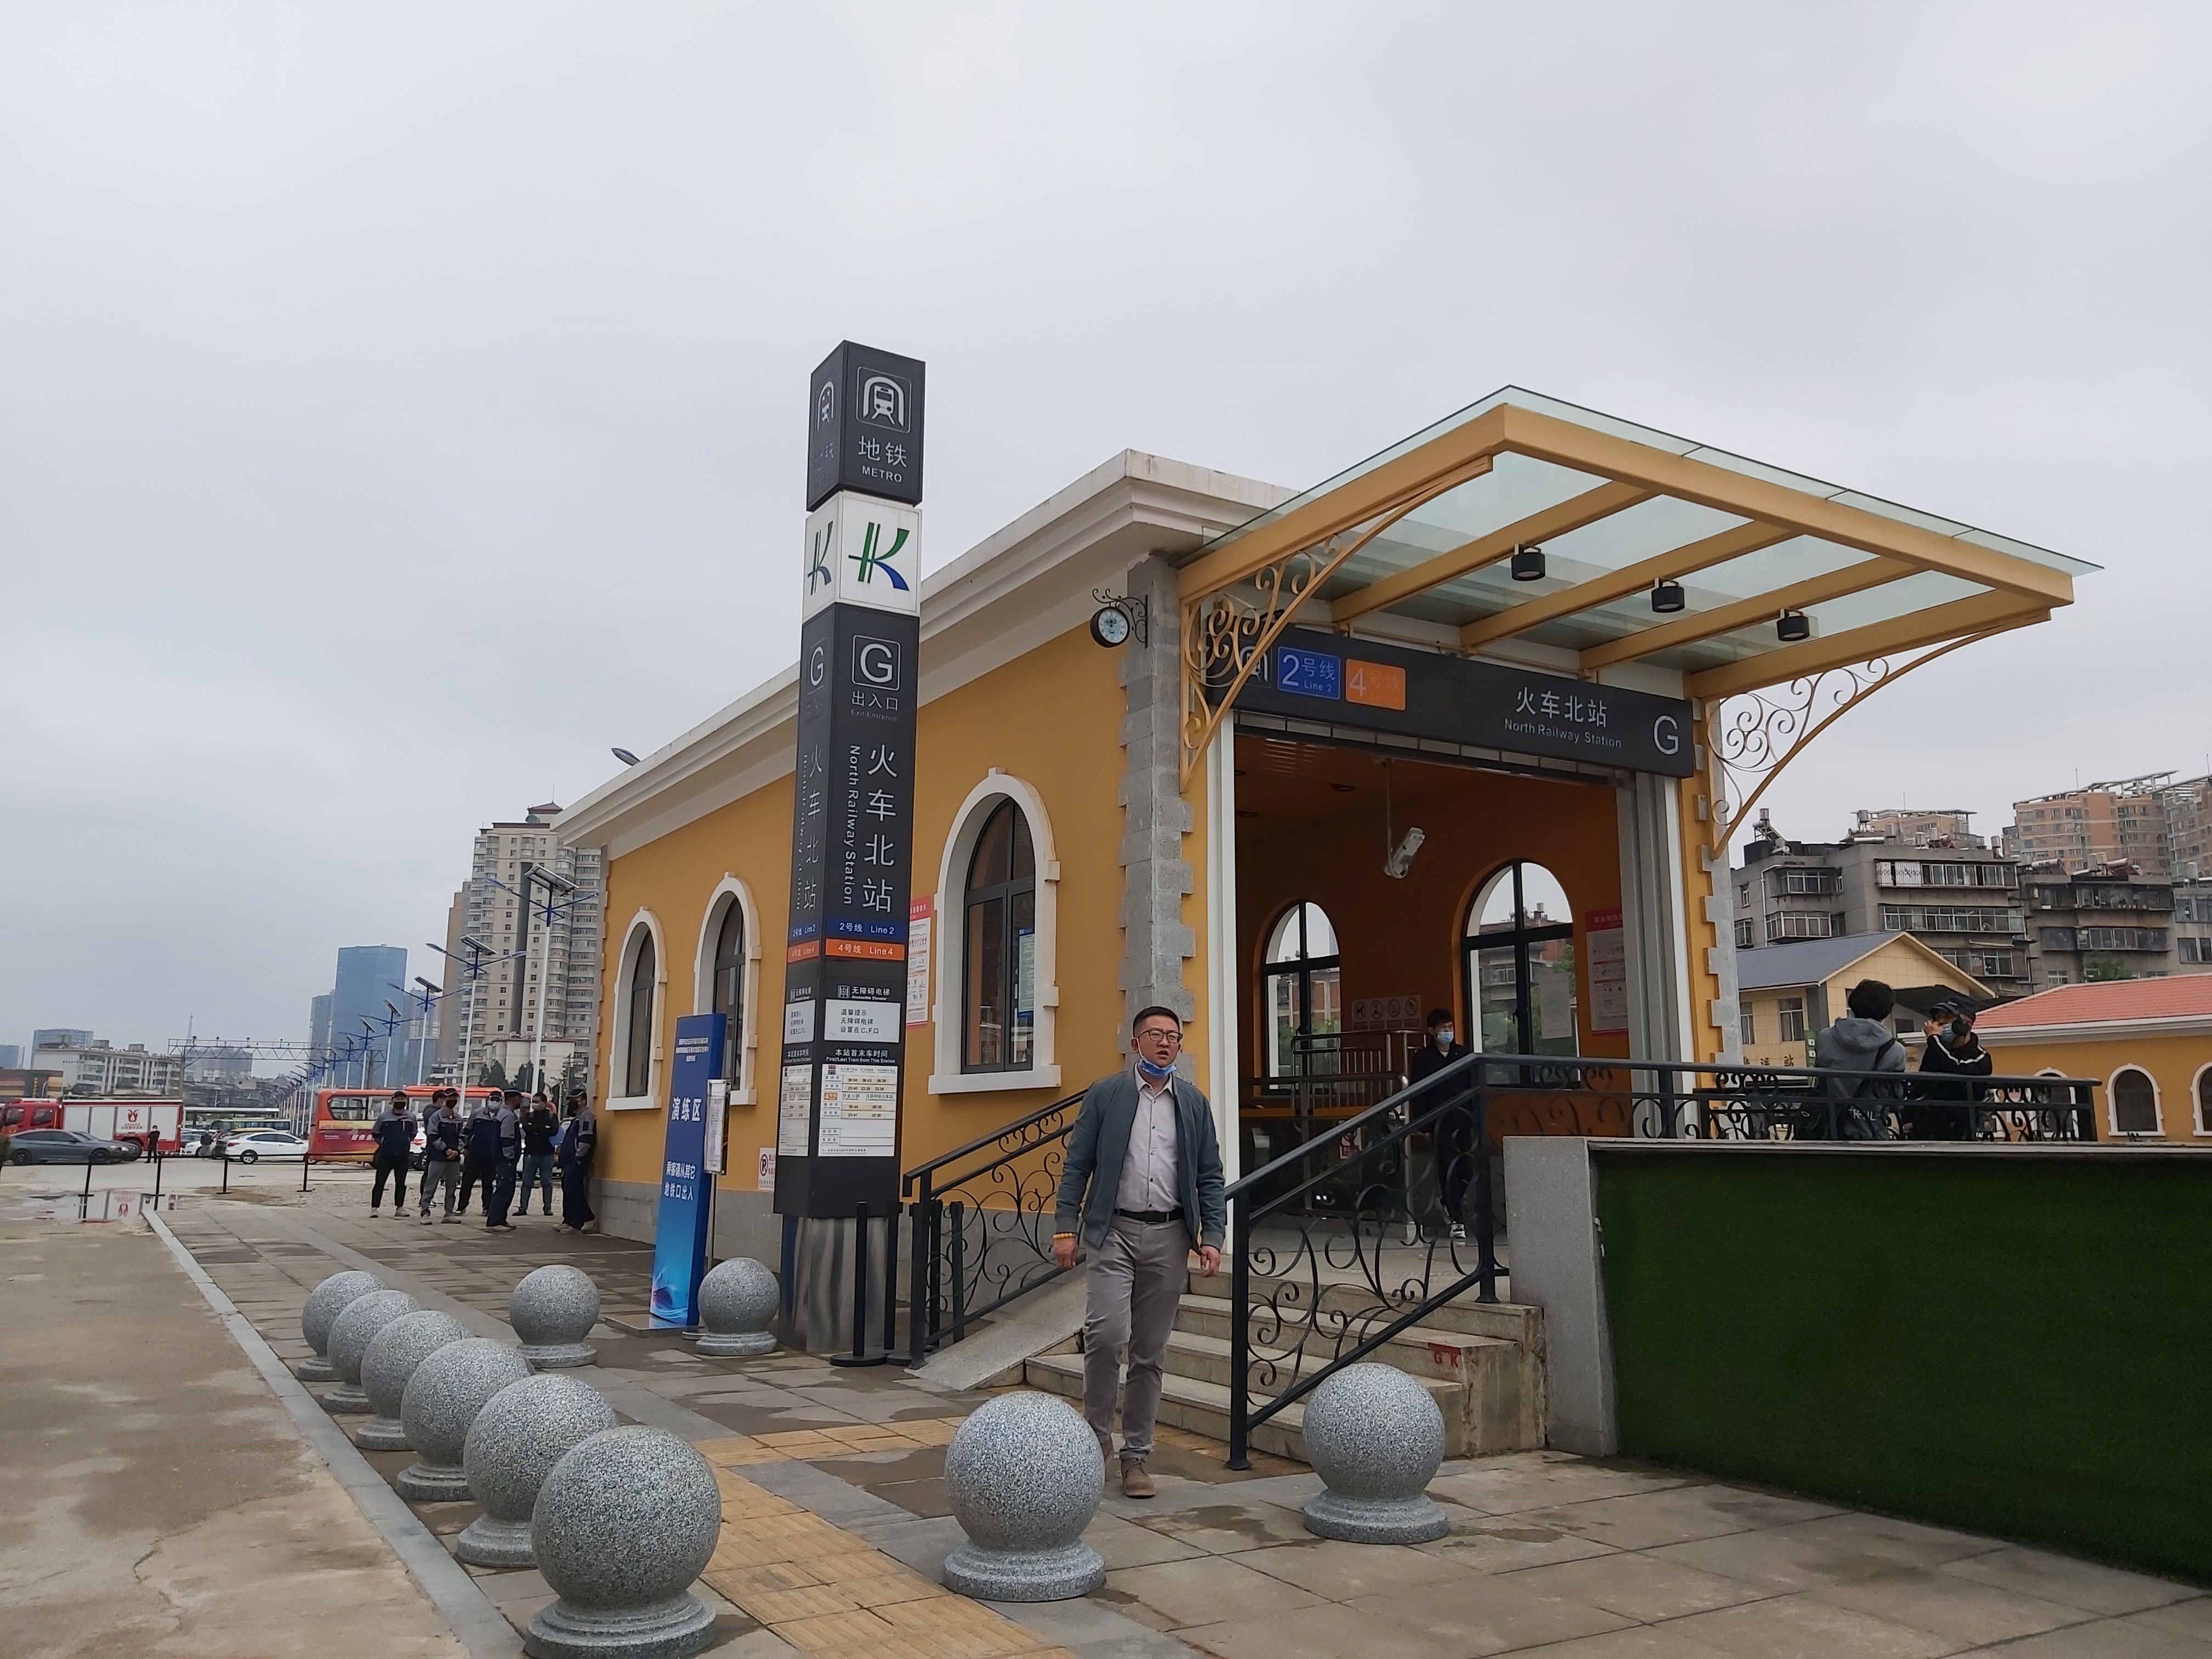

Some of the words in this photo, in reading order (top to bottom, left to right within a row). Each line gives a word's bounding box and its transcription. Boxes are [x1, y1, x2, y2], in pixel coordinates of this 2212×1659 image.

[858, 436, 907, 467] 地铁
[862, 465, 902, 483] METRO
[810, 646, 823, 687] G
[860, 643, 893, 684] G
[1282, 654, 1336, 687] 2号线
[852, 690, 898, 712] 出入口
[1304, 680, 1323, 691] Line
[1327, 684, 1333, 693] 2
[1516, 687, 1607, 728] 火车北站
[1505, 718, 1535, 734] North
[1538, 724, 1580, 744] Railway
[1584, 732, 1622, 749] Station
[1653, 715, 1679, 755] G
[849, 745, 861, 785] North
[804, 744, 822, 911] 火车北站
[844, 789, 859, 847] Railway
[862, 744, 898, 912] 火车北站
[844, 851, 856, 904] Station
[839, 923, 863, 933] 2号线
[838, 944, 862, 954] 4号线
[851, 986, 890, 996] 无障碍电梯
[835, 1048, 888, 1058] 本站首末车时间
[671, 1097, 702, 1122] 演练区
[664, 1181, 693, 1201] 地铁口出入
